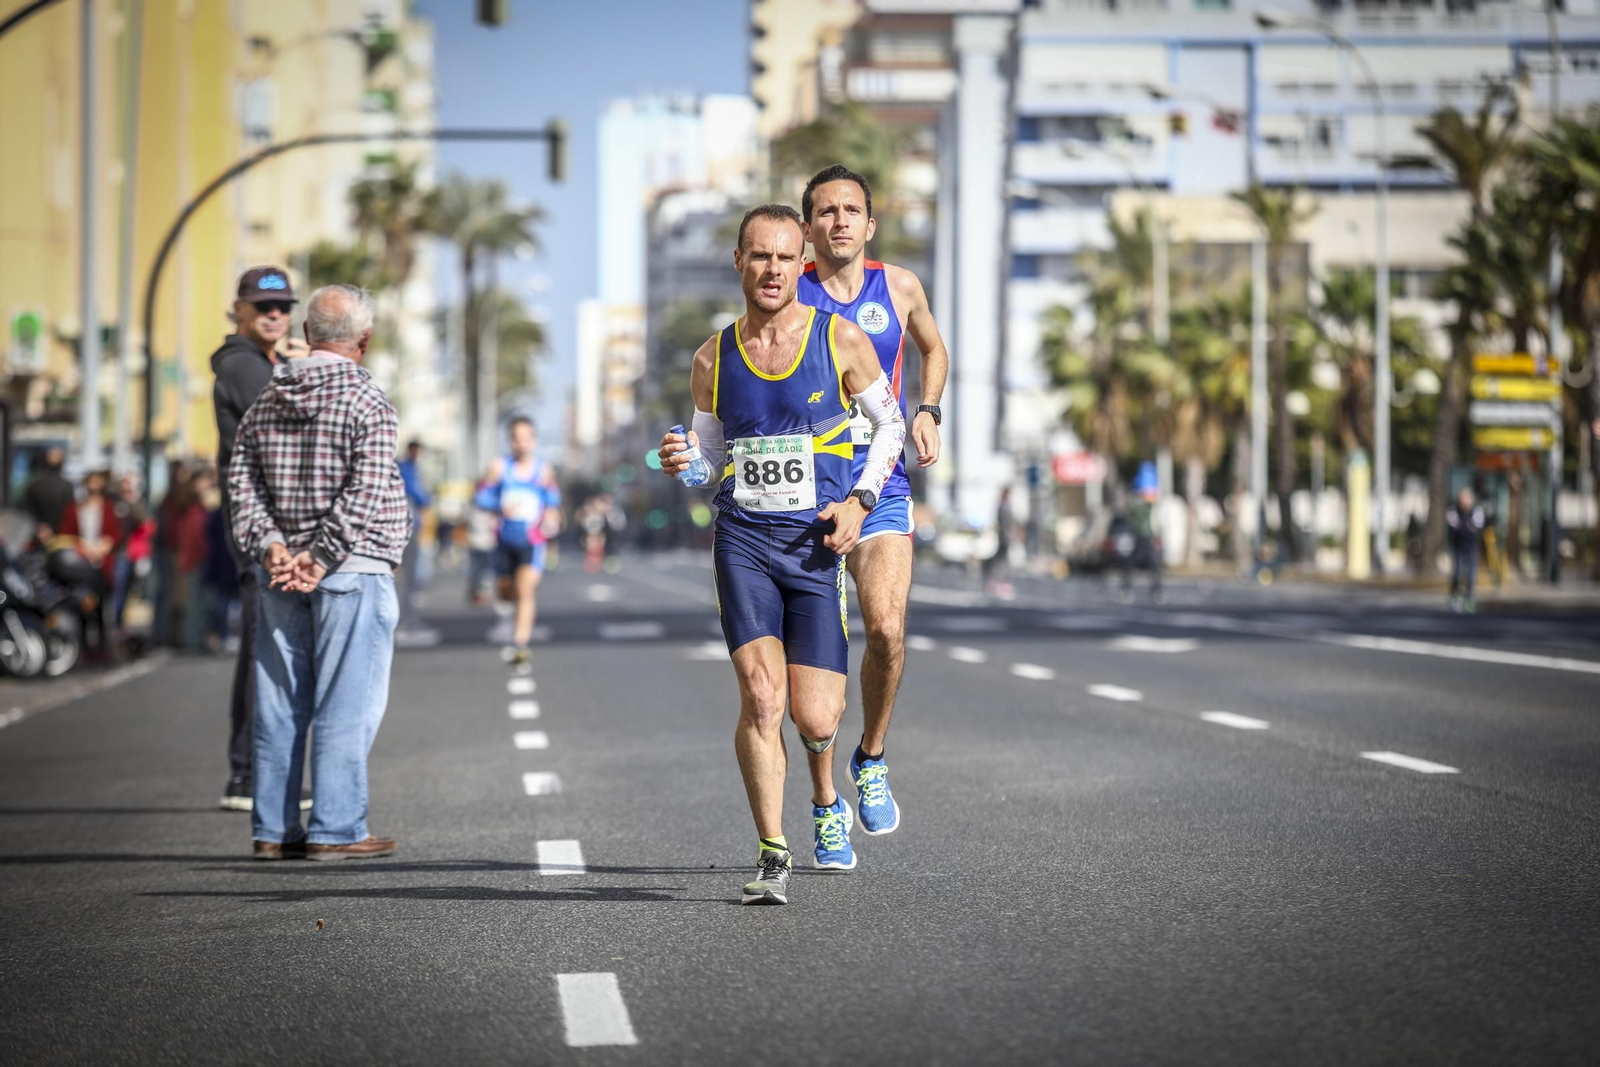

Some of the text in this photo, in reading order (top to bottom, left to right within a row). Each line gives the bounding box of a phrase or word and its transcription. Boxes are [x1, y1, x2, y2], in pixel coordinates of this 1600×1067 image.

[778, 444, 804, 454] CÁDIZ
[743, 459, 804, 486] 886
[788, 497, 799, 505] Dd
